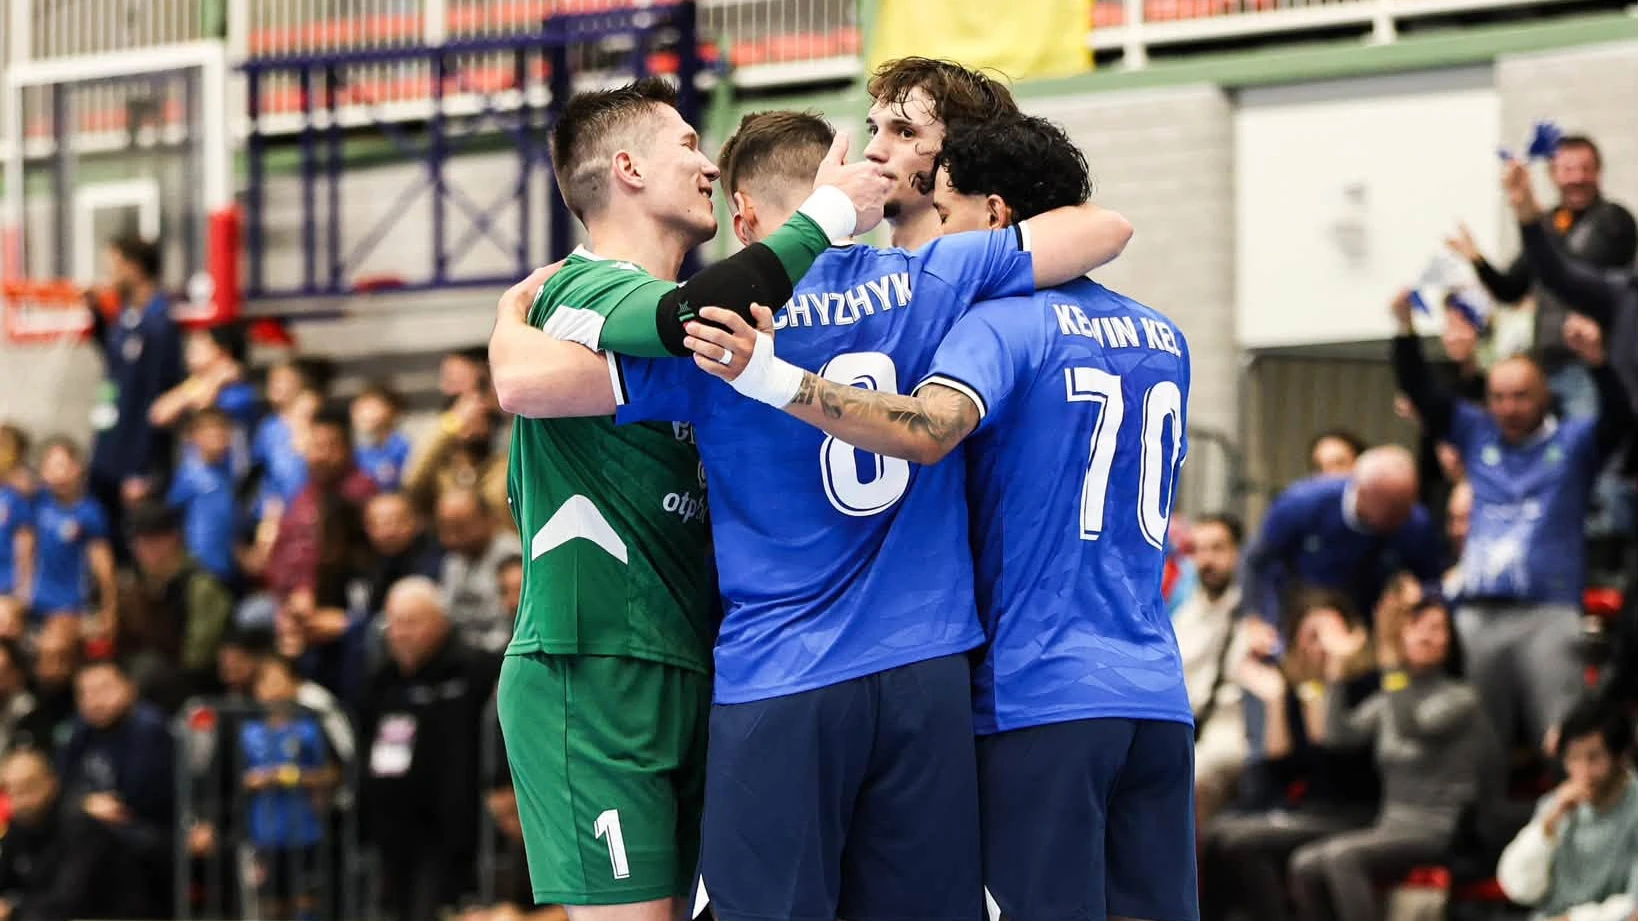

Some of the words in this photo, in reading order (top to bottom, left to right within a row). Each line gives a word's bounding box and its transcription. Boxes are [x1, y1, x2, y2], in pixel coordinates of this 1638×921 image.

[1052, 304, 1141, 349] KEVIN
[819, 351, 910, 517] 8
[1064, 367, 1182, 551] 70
[594, 808, 630, 880] 1
